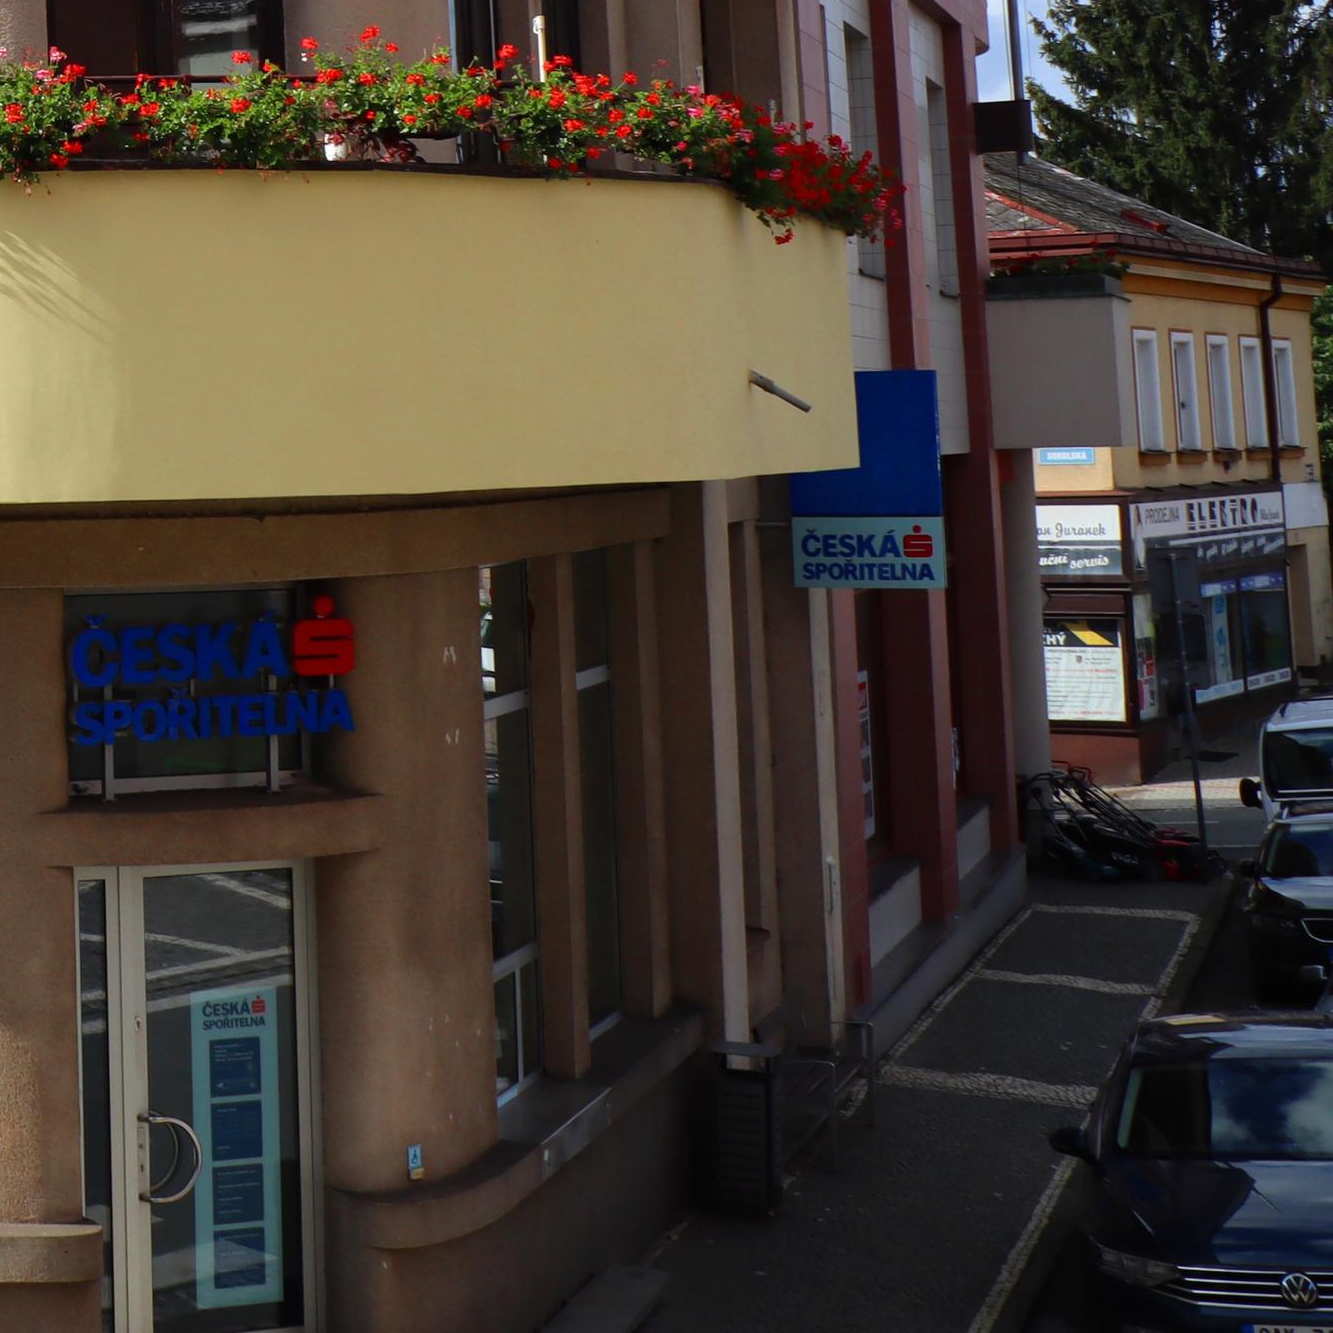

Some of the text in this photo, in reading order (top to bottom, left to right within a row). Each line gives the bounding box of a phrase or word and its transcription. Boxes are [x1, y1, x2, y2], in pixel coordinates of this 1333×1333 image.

[1186, 497, 1258, 530] ELEKTRO
[801, 528, 903, 558] ČESKÁ
[803, 559, 935, 581] SPOŘITELNA
[1069, 555, 1109, 570] servis
[72, 610, 290, 687] ČESKÁ
[73, 686, 355, 746] SPOŘITELNA
[202, 997, 250, 1017] ČESKÁ
[202, 1016, 266, 1030] SPOŘITELNA
